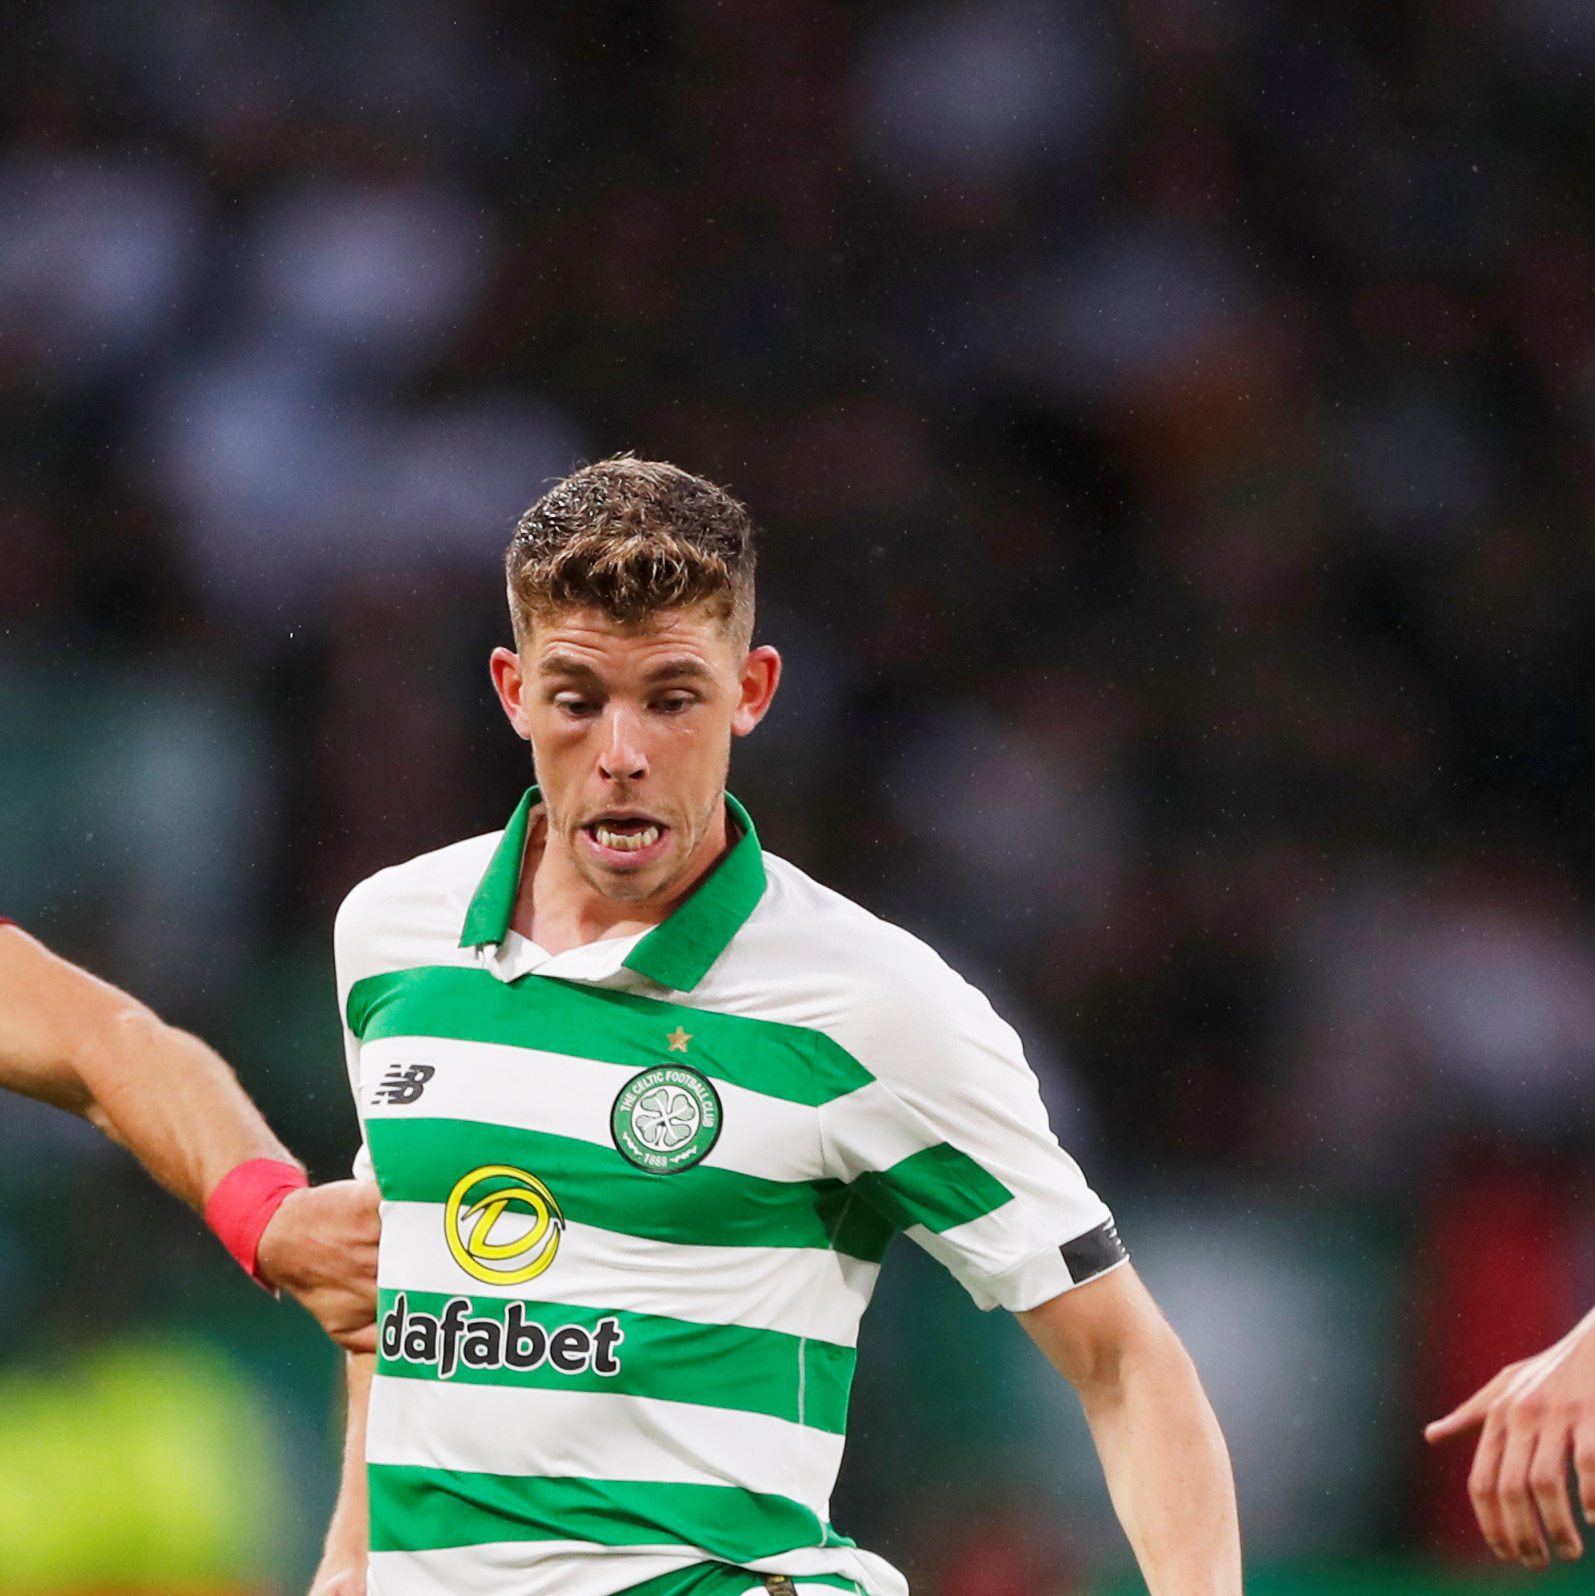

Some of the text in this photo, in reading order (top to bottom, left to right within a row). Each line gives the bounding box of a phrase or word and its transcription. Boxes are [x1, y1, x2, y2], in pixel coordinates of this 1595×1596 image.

[620, 1070, 715, 1128] THE CELTIC FOOTBALL CLUB
[380, 1294, 624, 1379] dafabet
